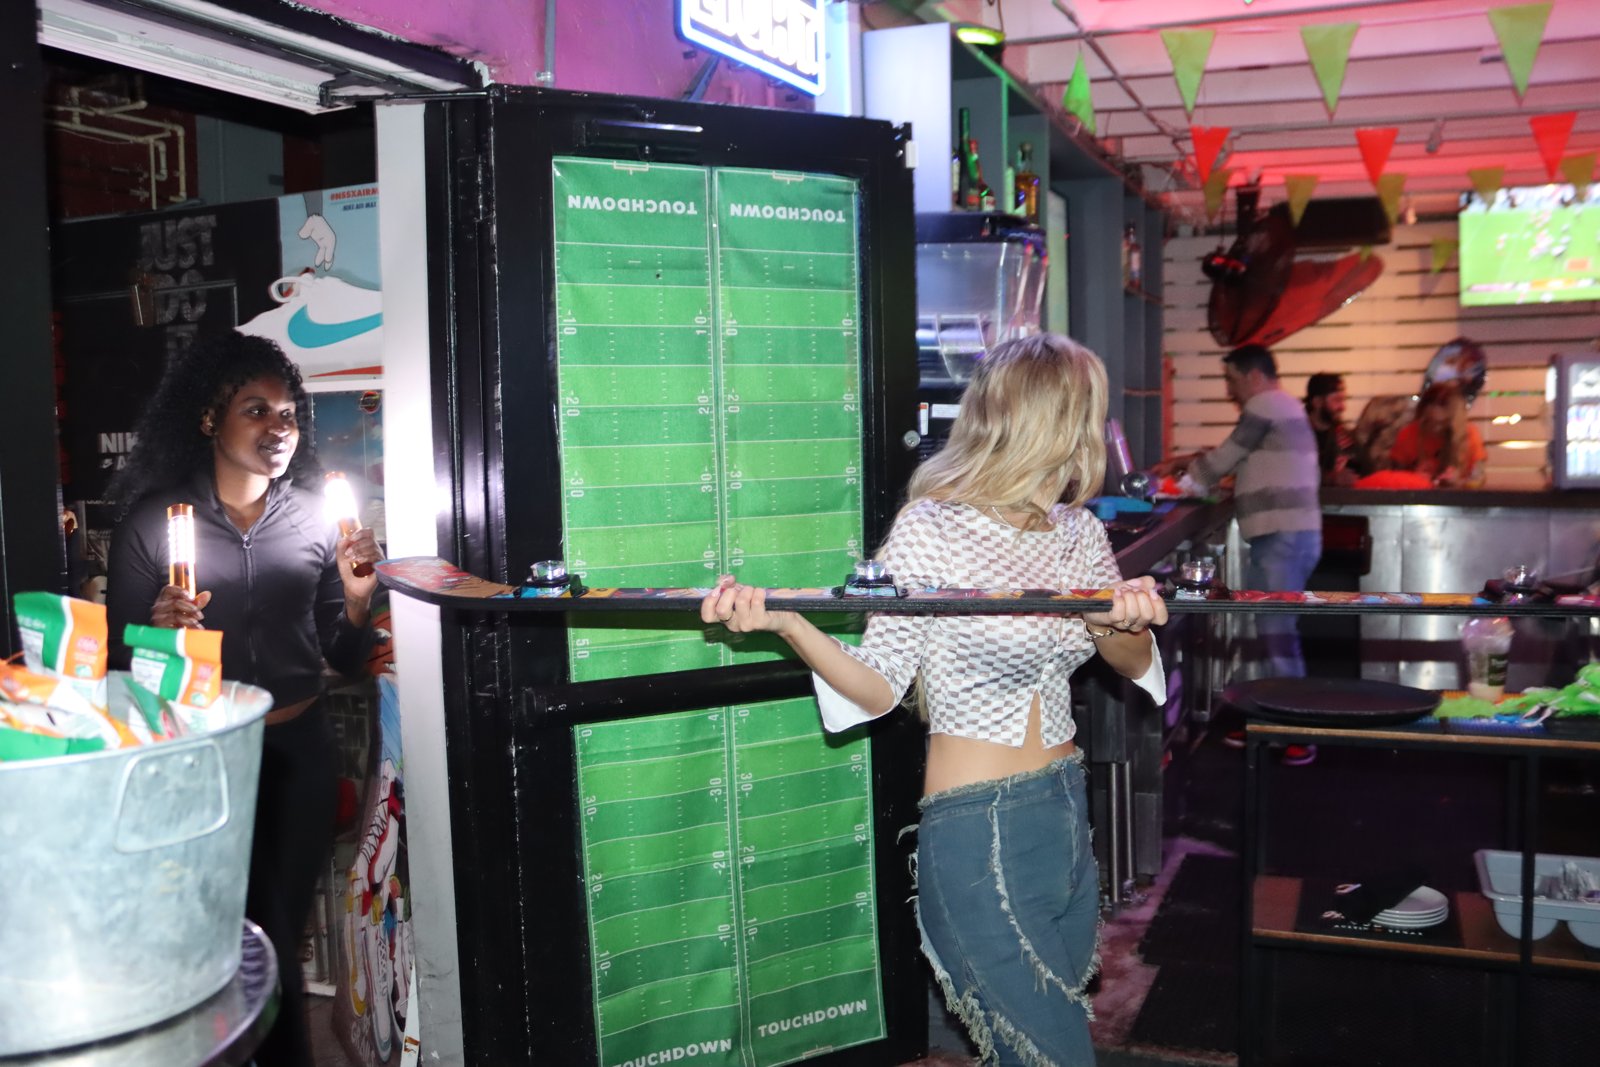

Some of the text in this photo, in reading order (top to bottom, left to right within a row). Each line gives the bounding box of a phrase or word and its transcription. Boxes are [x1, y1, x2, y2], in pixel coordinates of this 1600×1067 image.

[567, 194, 698, 215] TOUCHDOWN
[729, 203, 846, 223] TOUCHDOWN
[137, 214, 217, 271] JUST
[100, 432, 139, 453] NIK
[757, 1000, 868, 1038] TOUCHDOWN
[611, 1038, 732, 1067] OUCHDOWN
